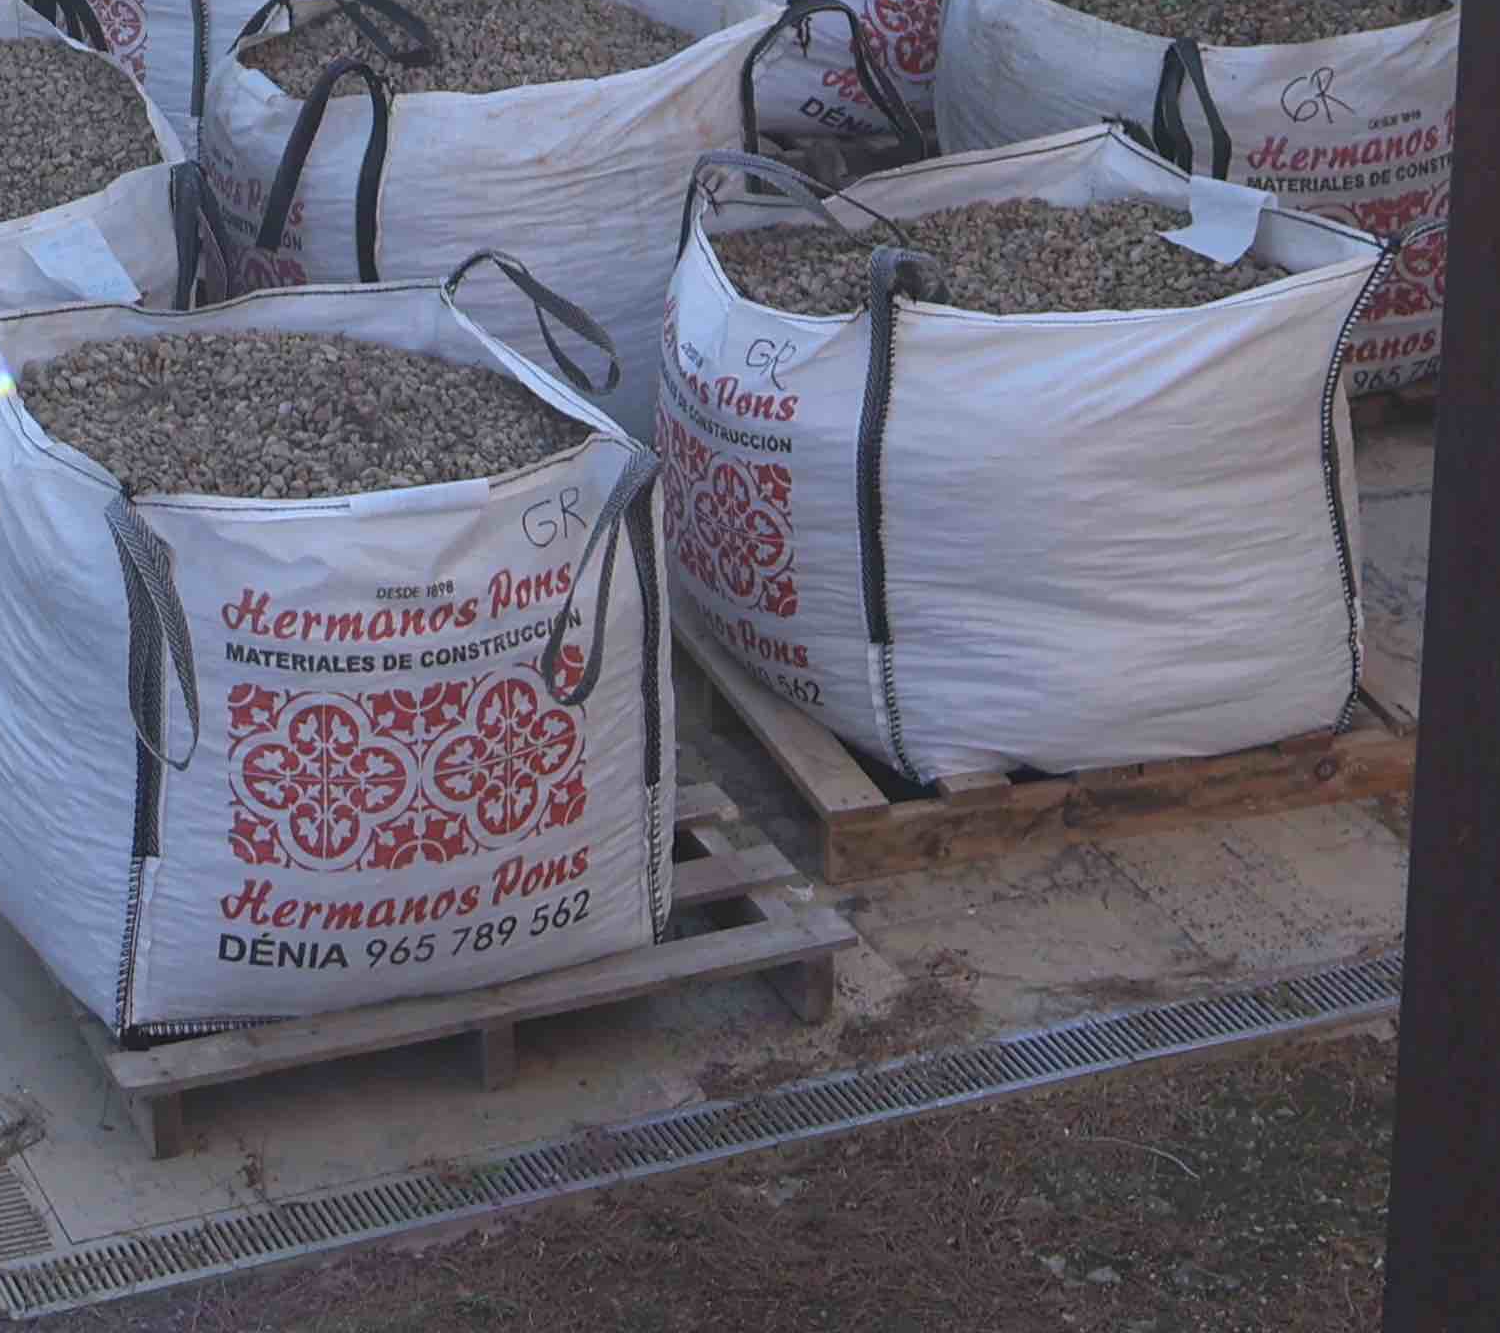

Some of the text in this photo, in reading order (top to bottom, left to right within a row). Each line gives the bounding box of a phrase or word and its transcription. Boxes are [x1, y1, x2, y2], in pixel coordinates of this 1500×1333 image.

[1248, 124, 1439, 171] Hermanos
[1247, 172, 1364, 193] MATERIALES
[1369, 169, 1391, 186] DE
[746, 338, 797, 391] GR
[714, 375, 799, 422] Pons
[522, 486, 588, 547] GR
[221, 561, 573, 643] Hermanos Pons
[376, 579, 455, 600] DESDE 1898
[224, 607, 583, 674] MATERIALES DE CONSTRUCCIN
[736, 618, 809, 669] Pons
[776, 674, 825, 707] 562
[219, 844, 592, 932] Hermanos Pons
[217, 888, 592, 970] DÉNIA 965 789 562
